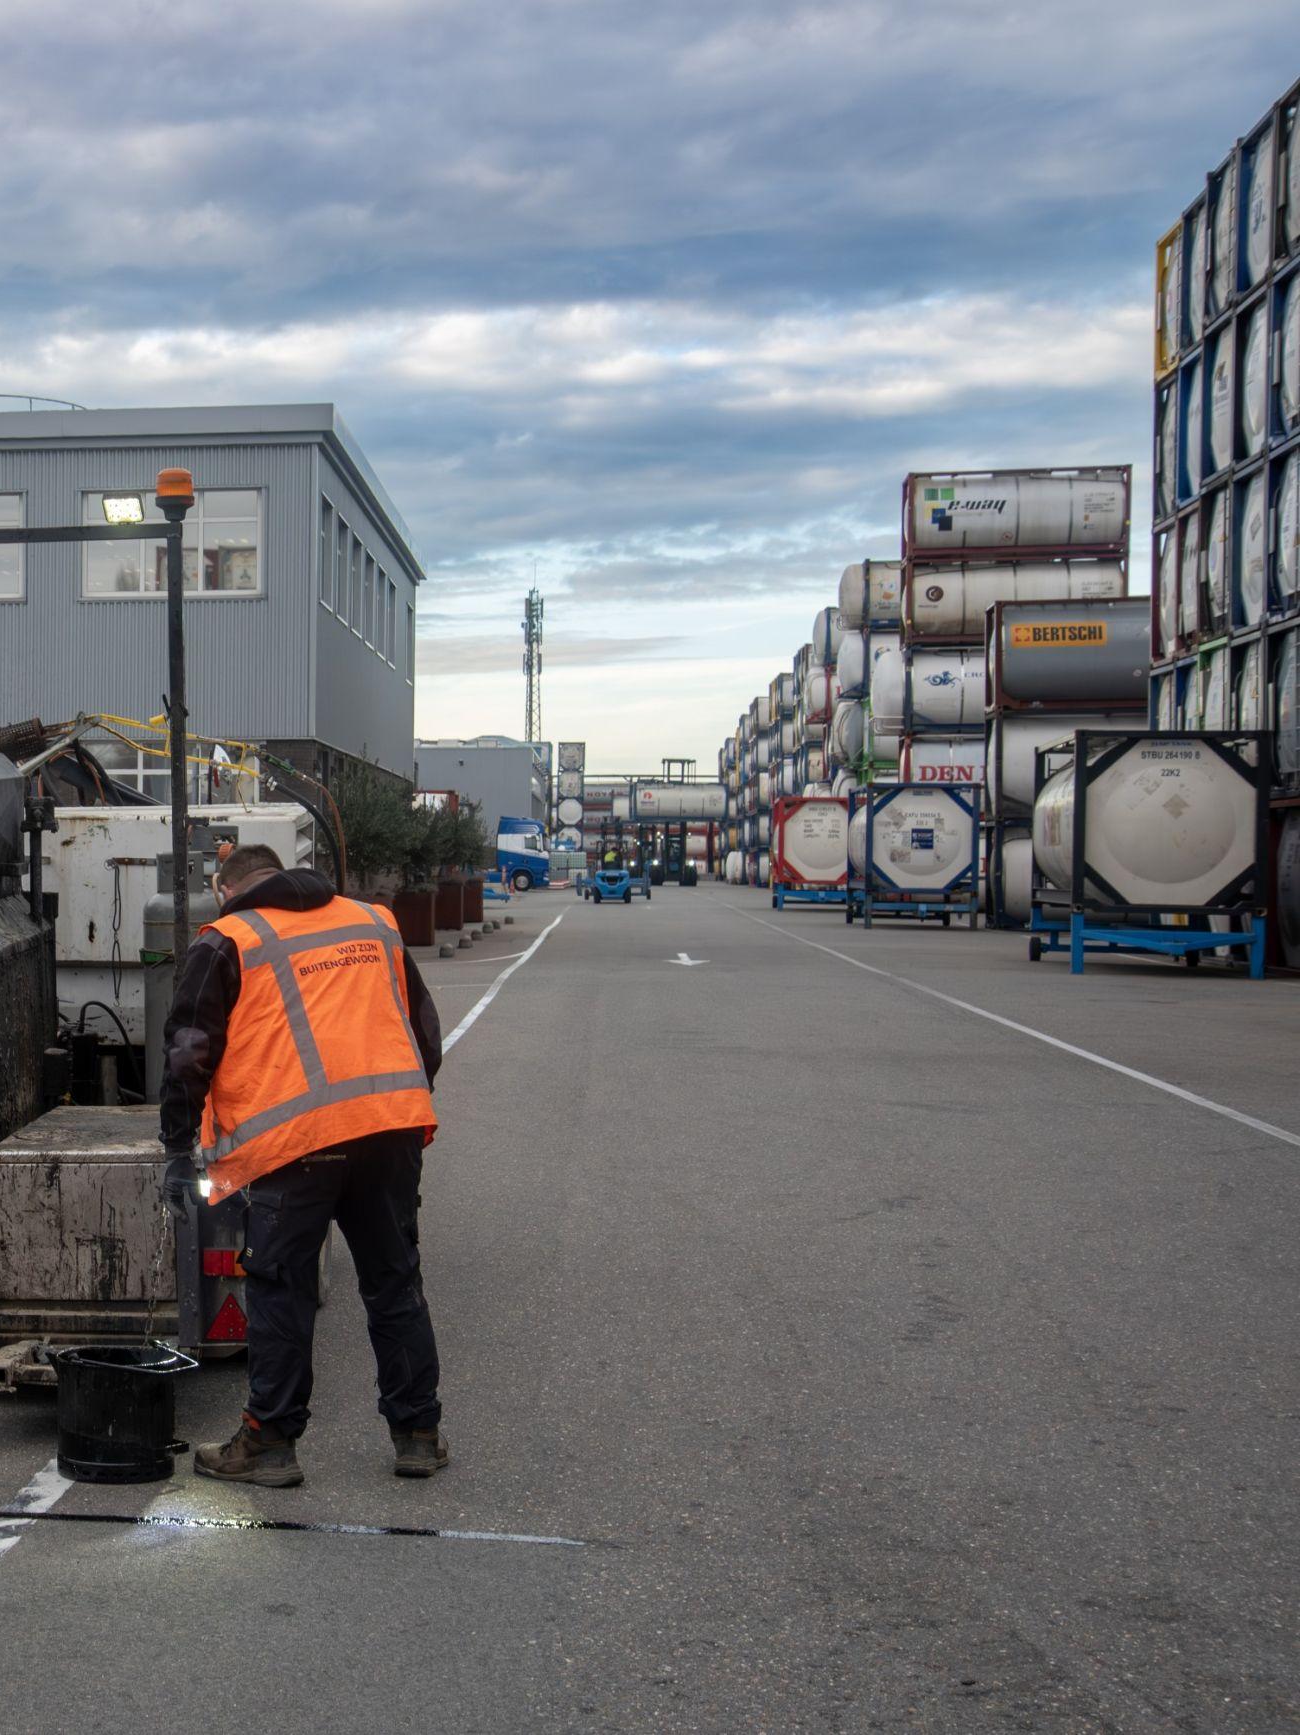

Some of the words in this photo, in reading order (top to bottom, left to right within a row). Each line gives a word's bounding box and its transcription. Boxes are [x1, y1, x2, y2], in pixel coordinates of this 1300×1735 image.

[947, 499, 1007, 515] e-way
[1032, 625, 1104, 642] BERTSCHI
[1141, 751, 1163, 760] STBU
[918, 765, 975, 781] DEN
[1161, 768, 1181, 777] 22K2
[336, 945, 357, 955] WIJ
[358, 943, 378, 952] ZIJN
[299, 954, 381, 976] BUITENGEWOON
